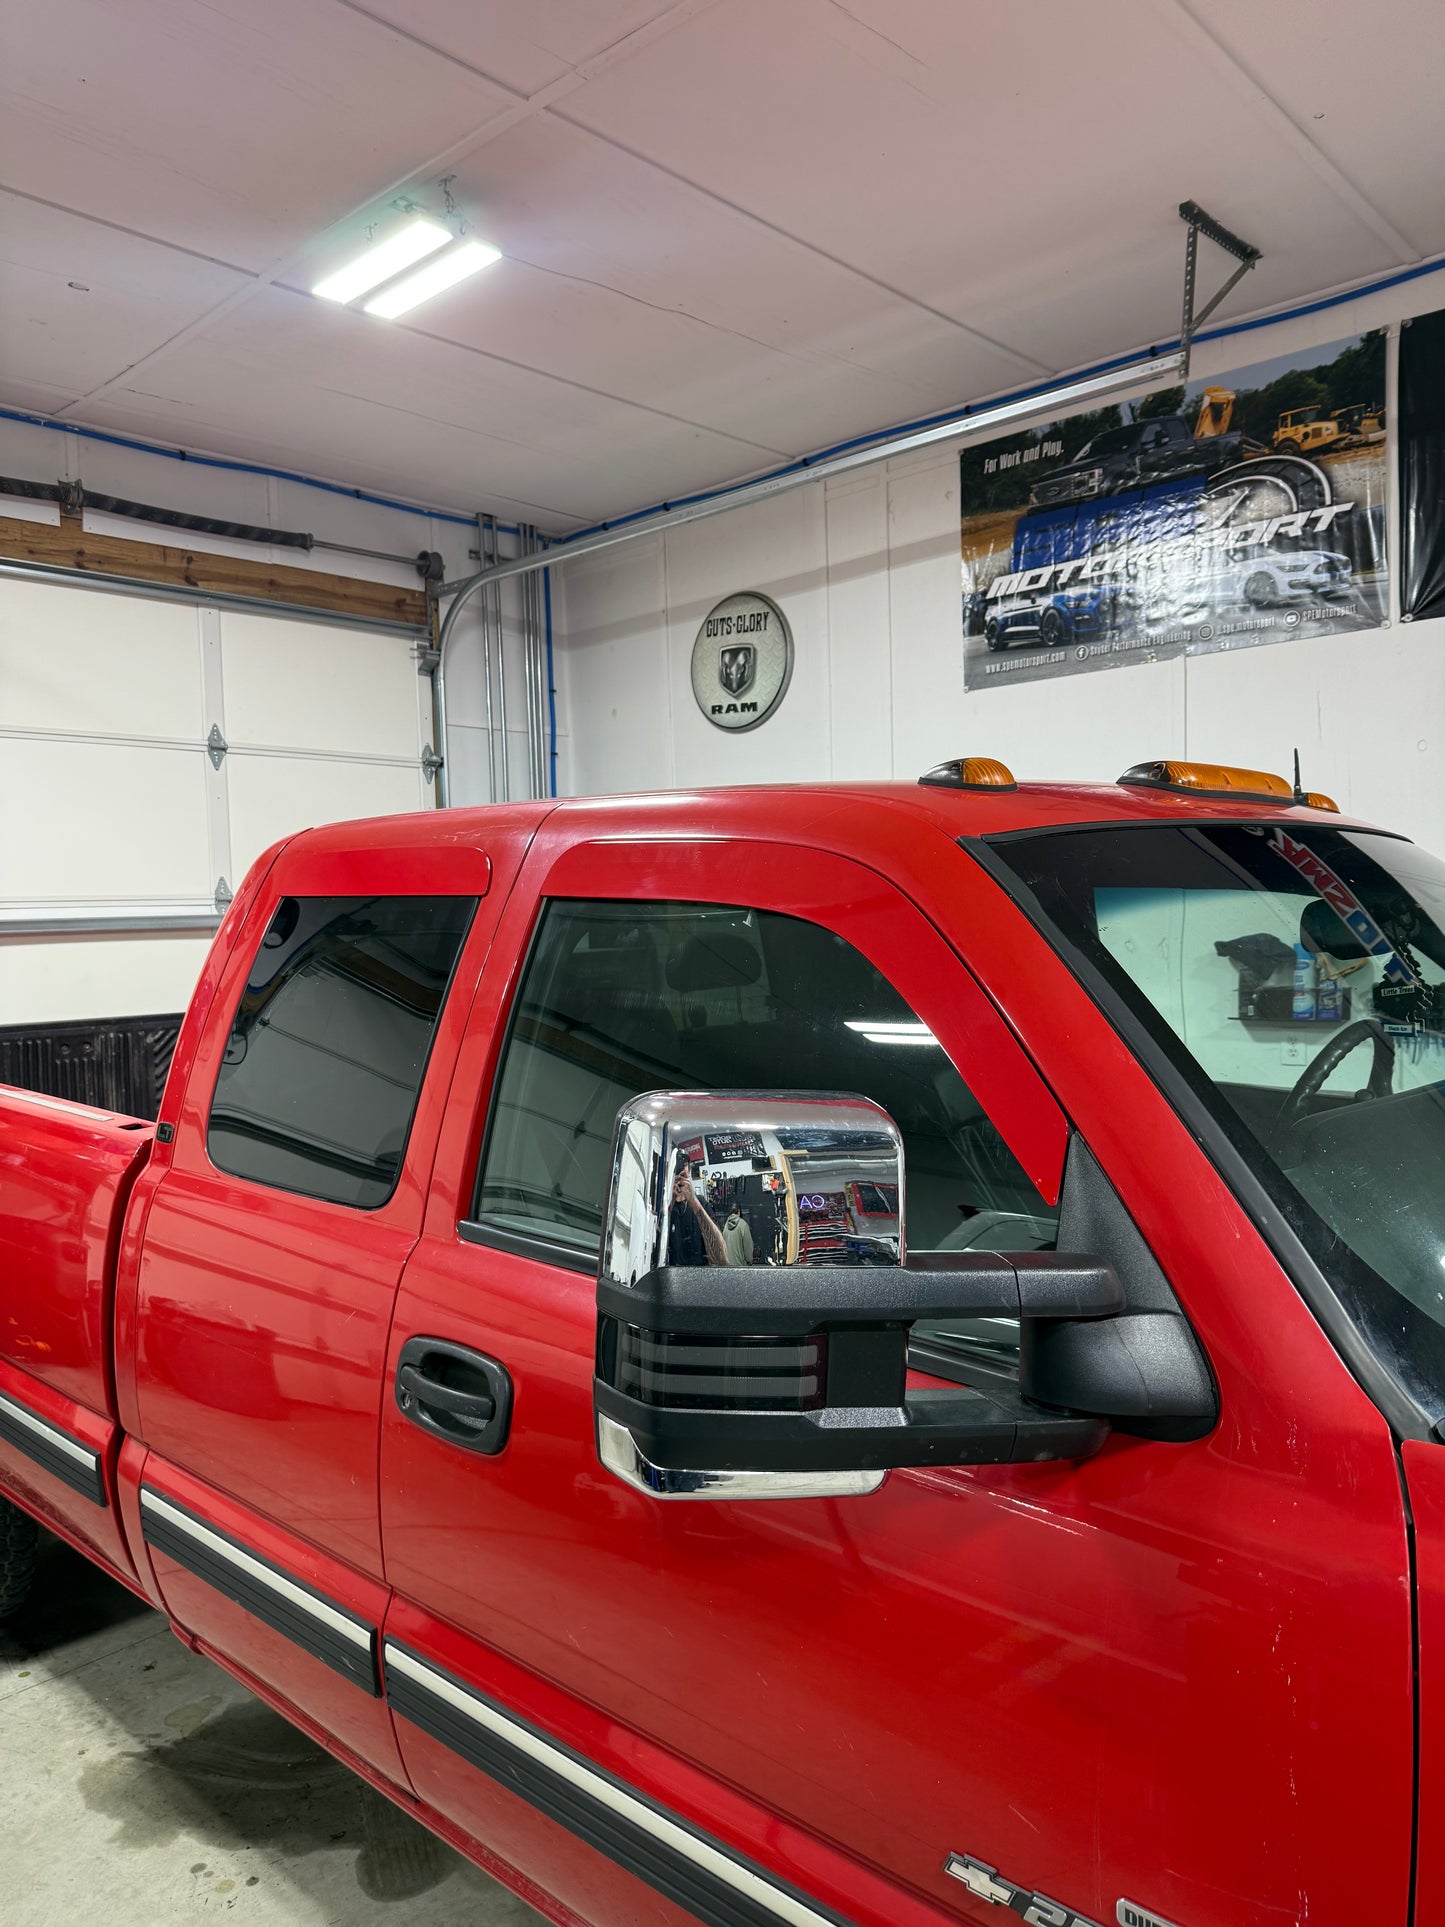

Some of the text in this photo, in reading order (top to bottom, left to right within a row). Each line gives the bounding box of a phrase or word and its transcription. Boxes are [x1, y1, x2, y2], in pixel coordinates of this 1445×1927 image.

[984, 440, 1064, 474] For Work and Play.
[985, 651, 1066, 674] www.spemotorsport.com
[711, 702, 758, 715] RAM
[1383, 986, 1414, 996] Little Trees
